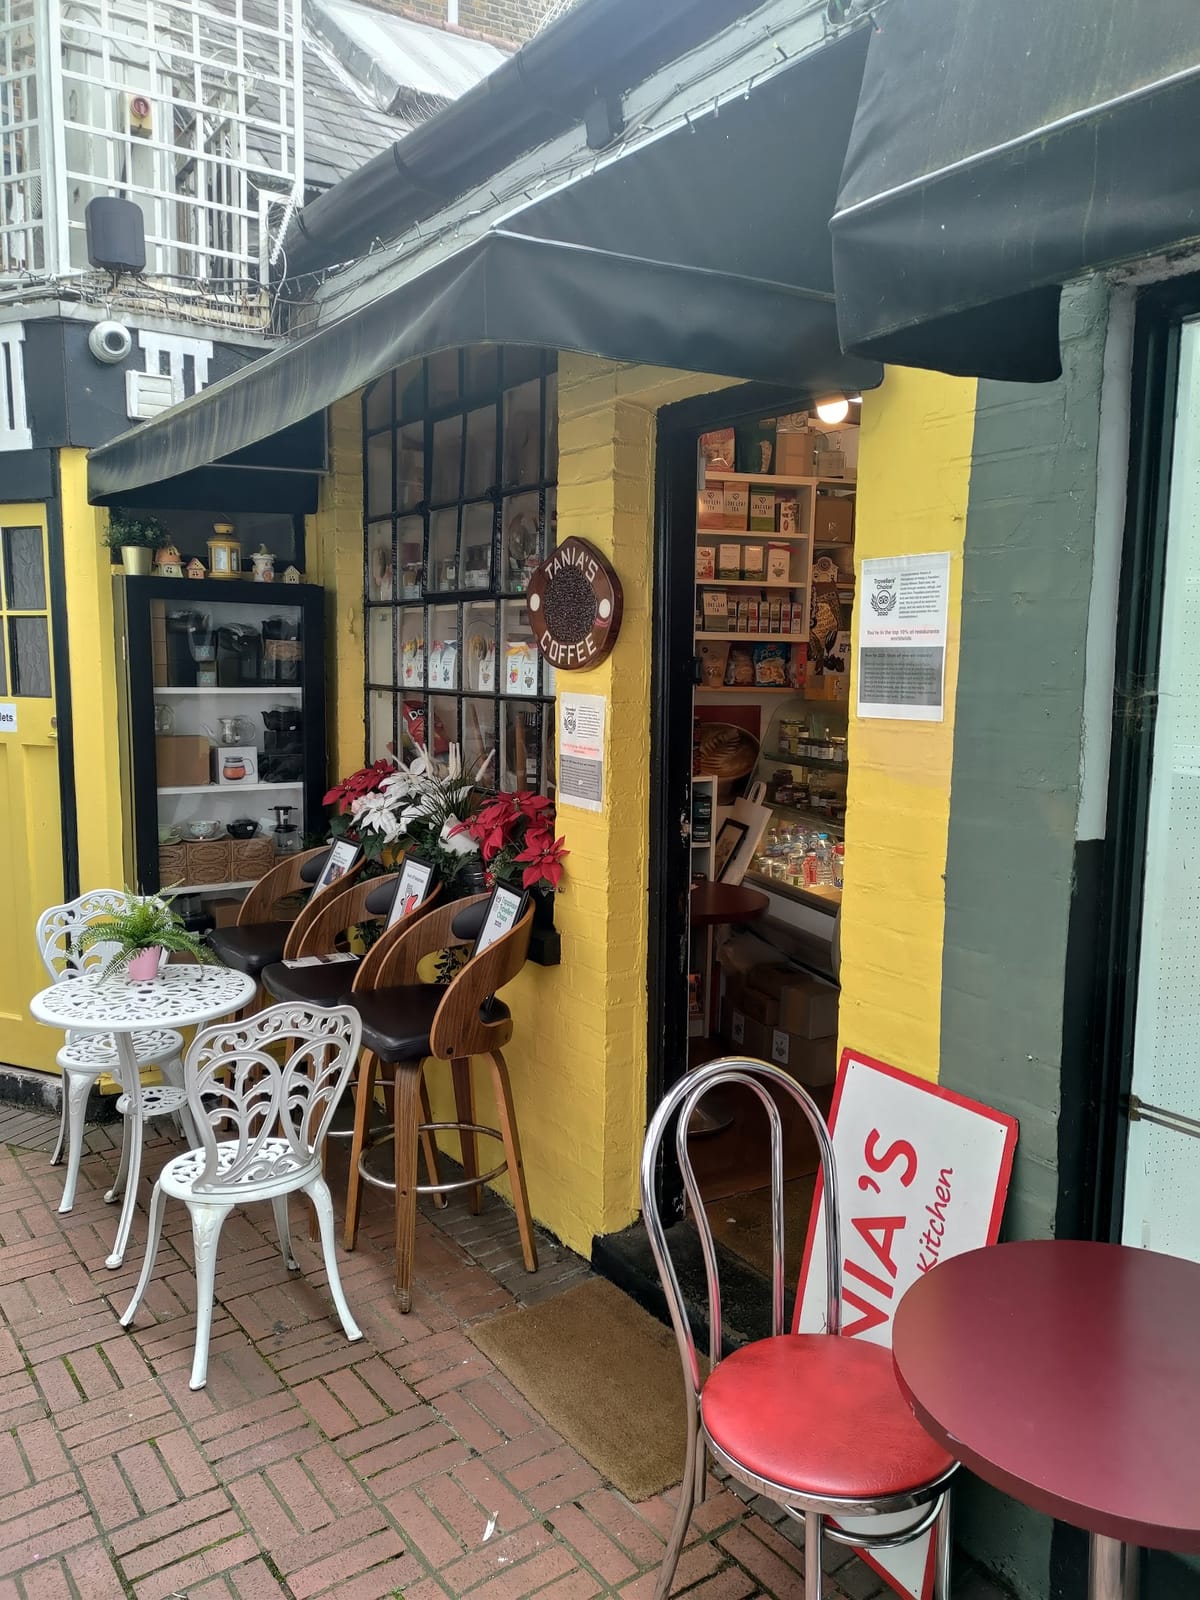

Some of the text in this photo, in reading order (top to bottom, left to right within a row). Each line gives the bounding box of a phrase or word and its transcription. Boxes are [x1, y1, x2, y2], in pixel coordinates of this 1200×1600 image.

[545, 547, 599, 583] TANIA'S
[540, 632, 597, 665] COFFEE
[916, 1167, 953, 1273] Kitchen
